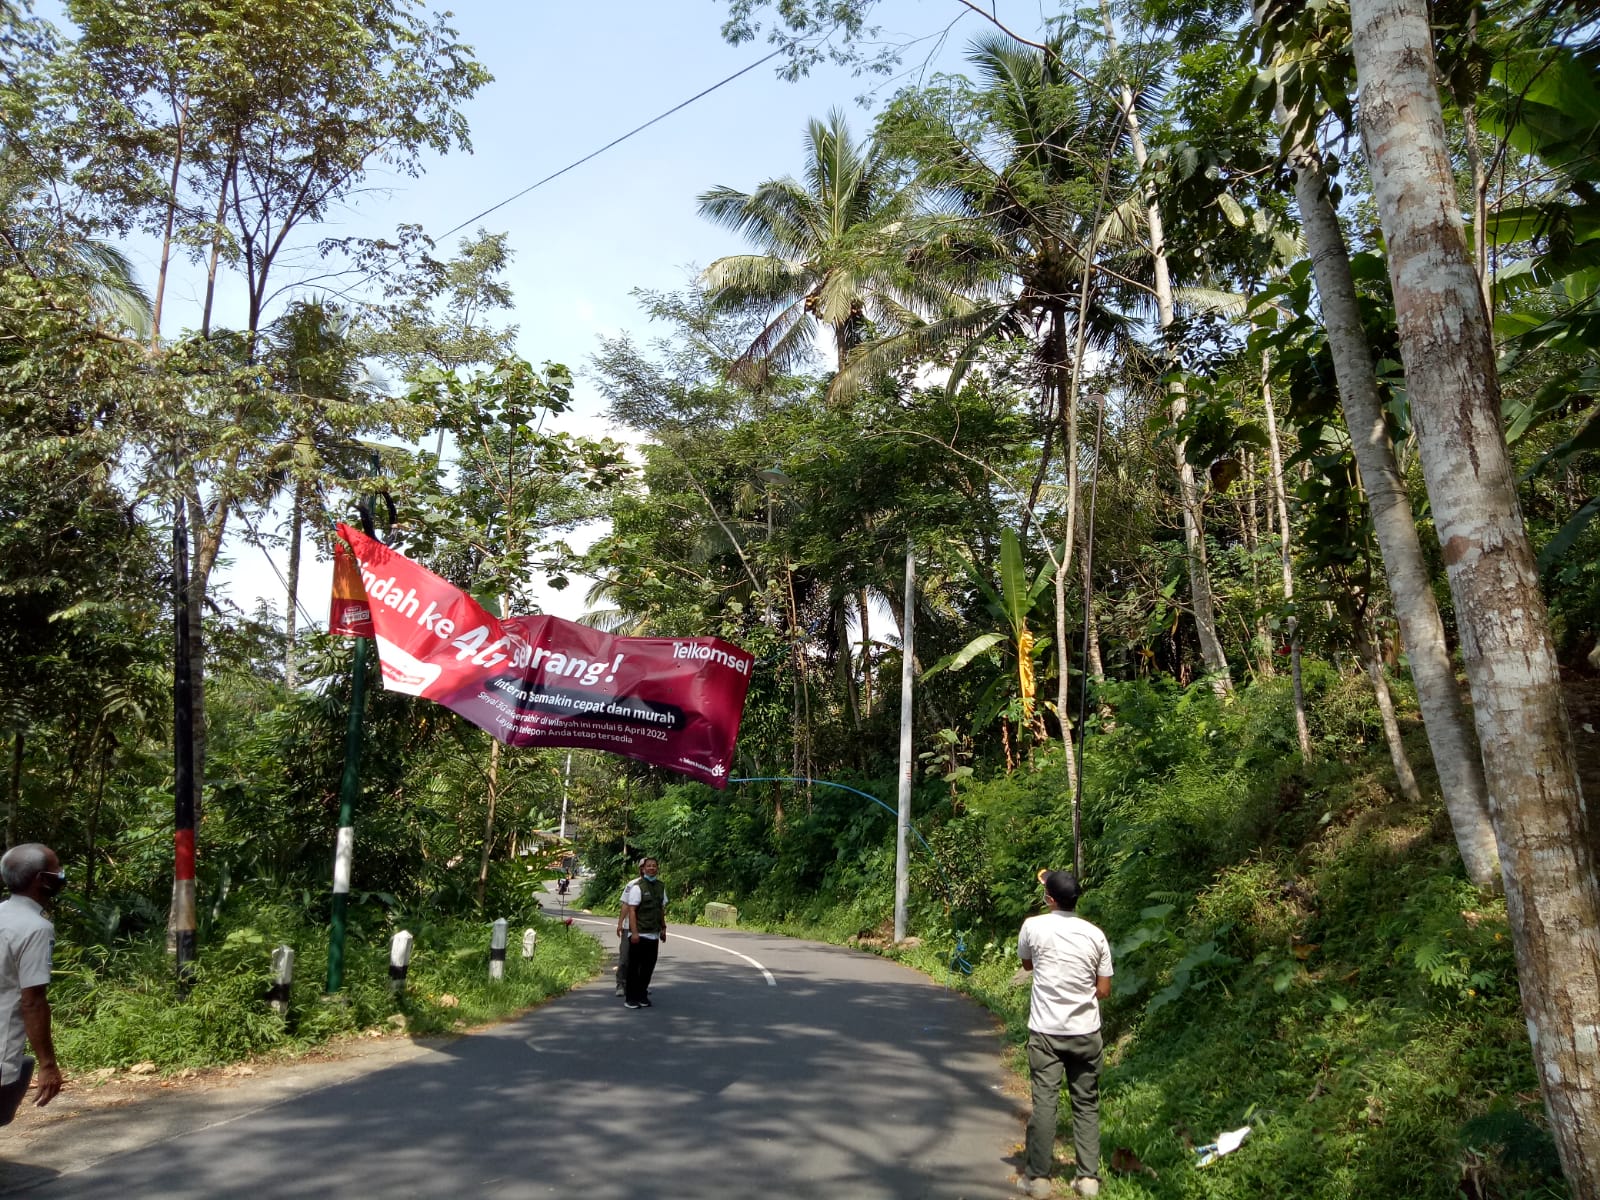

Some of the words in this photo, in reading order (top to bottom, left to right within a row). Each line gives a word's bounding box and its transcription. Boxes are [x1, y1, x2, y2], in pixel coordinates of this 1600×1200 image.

[356, 557, 420, 618] ndah
[417, 602, 455, 639] ke
[451, 625, 511, 668] 4G
[672, 642, 750, 676] Telkomsel
[477, 691, 497, 705] Sinyal
[495, 701, 508, 712] 3G
[540, 716, 548, 725] di
[548, 718, 579, 728] wilayah
[580, 720, 591, 728] ini
[592, 722, 616, 731] mulai
[624, 726, 646, 735] April
[528, 691, 572, 708] semakin
[573, 699, 606, 713] cepat
[606, 702, 630, 717] dan
[633, 708, 675, 723] murah
[573, 730, 596, 739] tetap
[598, 733, 633, 743] tersedia
